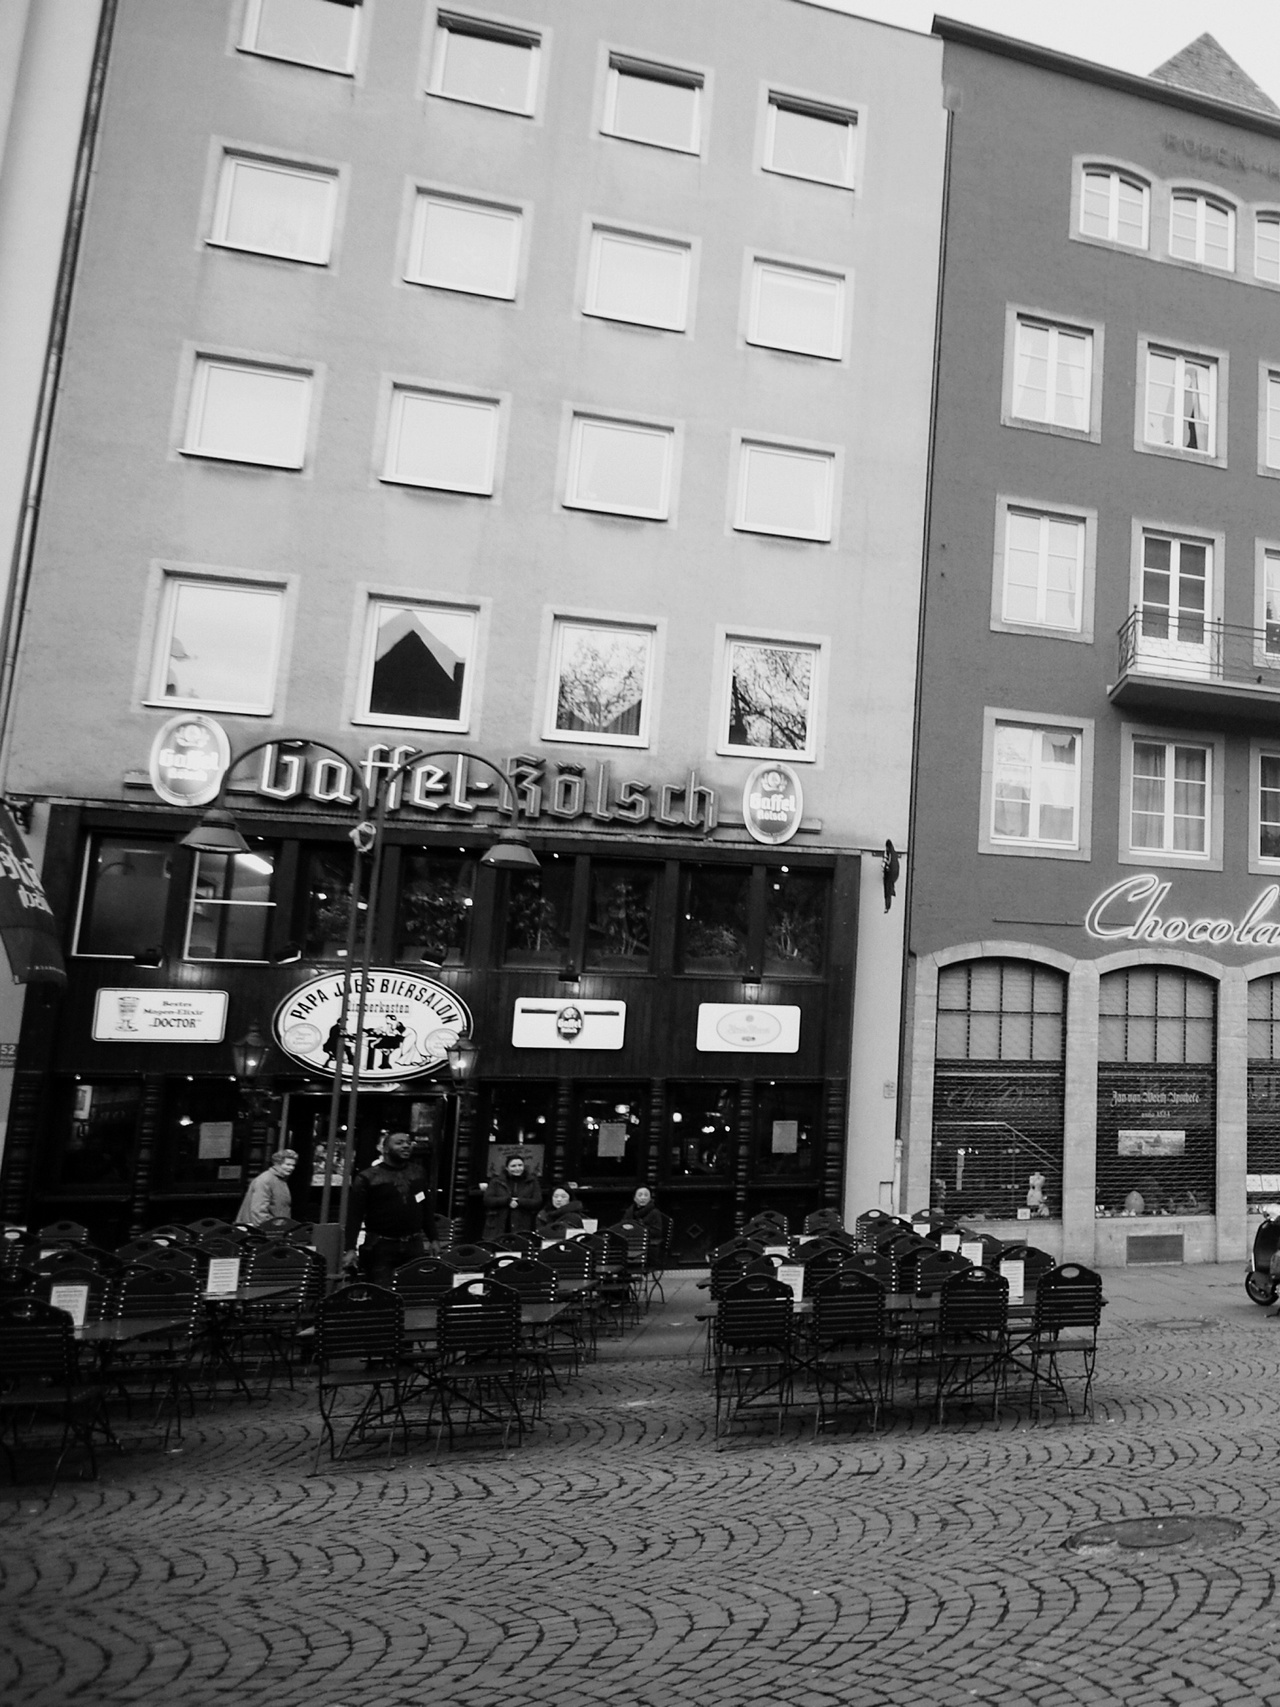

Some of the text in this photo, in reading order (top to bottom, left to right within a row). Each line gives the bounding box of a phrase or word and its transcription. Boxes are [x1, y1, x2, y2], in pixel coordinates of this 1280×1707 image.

[290, 988, 329, 1020] PAPA
[380, 978, 459, 1025] BIERSALON
[1, 1044, 16, 1055] 52
